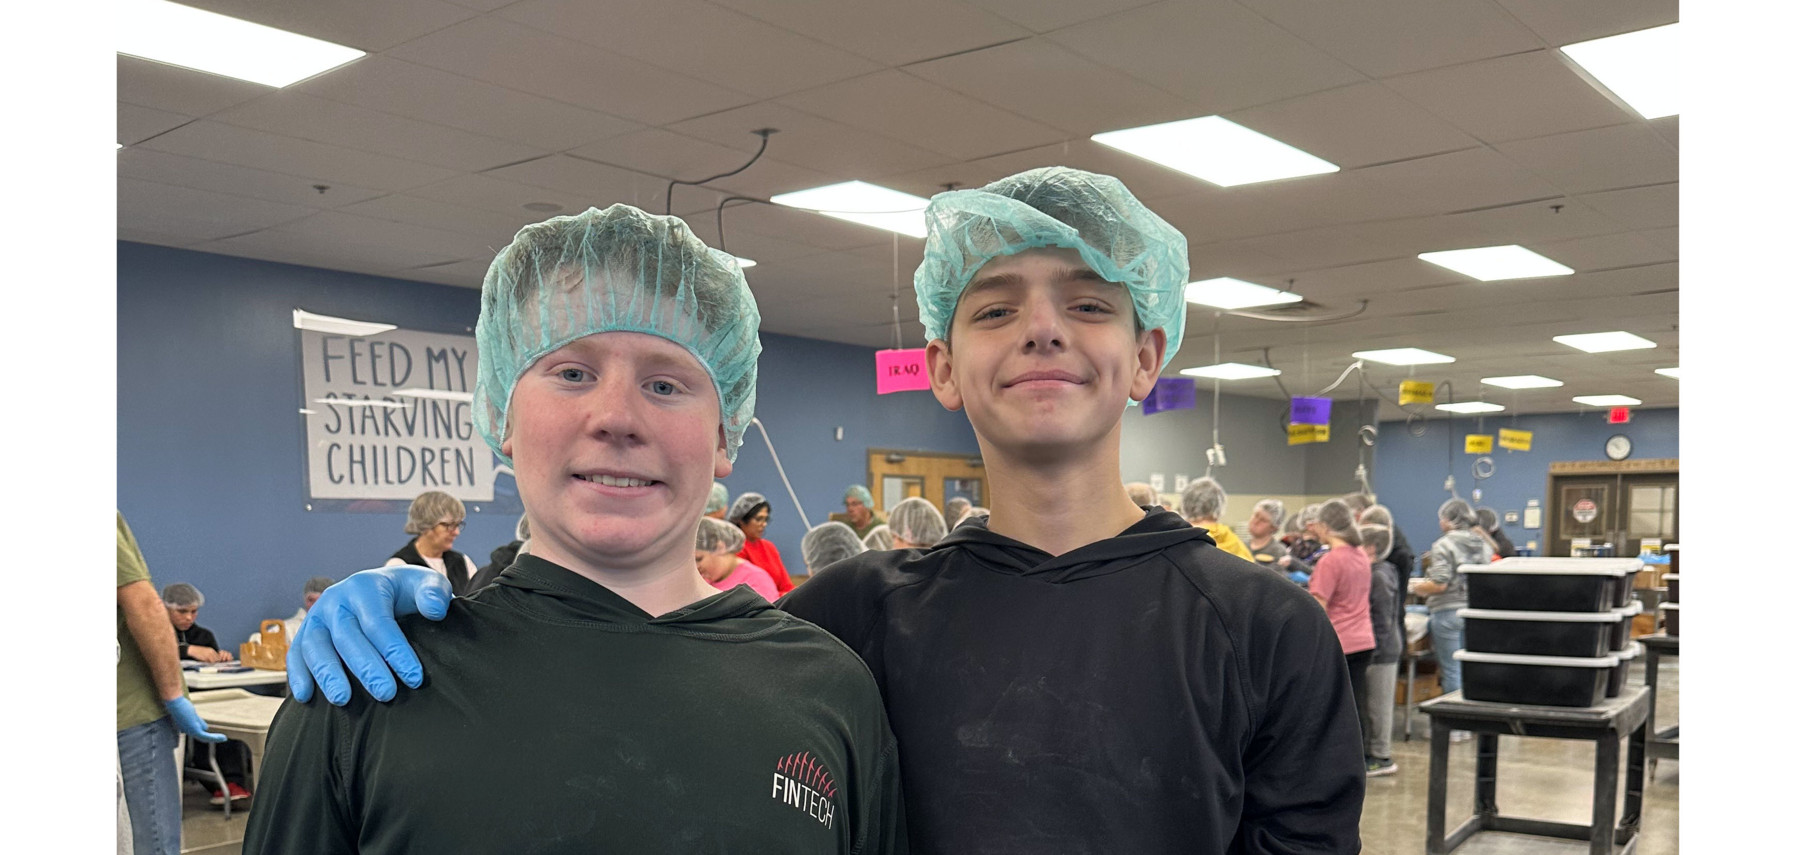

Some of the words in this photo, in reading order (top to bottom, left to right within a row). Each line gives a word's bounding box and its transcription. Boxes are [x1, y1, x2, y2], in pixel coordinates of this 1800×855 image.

[322, 336, 413, 387] FEED
[426, 346, 467, 392] MY
[888, 363, 920, 377] IRAQ
[324, 392, 474, 441] STARVING
[327, 443, 476, 487] CHILDREN
[772, 772, 835, 830] FINTECH
